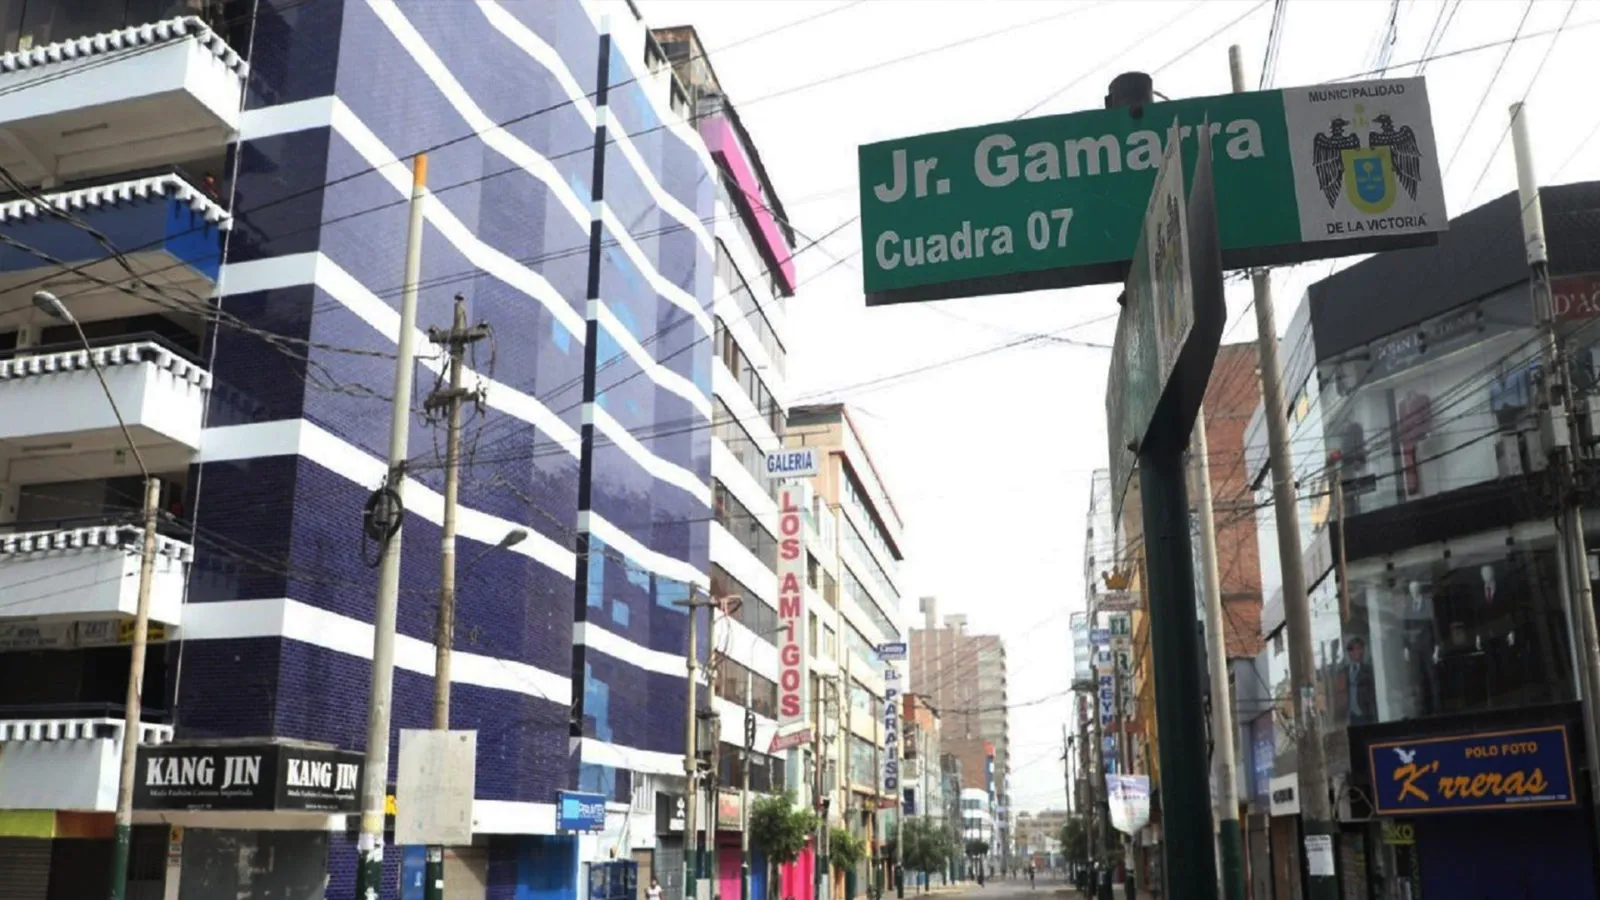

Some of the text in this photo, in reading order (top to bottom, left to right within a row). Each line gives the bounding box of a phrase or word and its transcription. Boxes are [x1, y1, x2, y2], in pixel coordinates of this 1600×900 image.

[1308, 84, 1405, 103] MUNICIPALIDAD
[873, 149, 950, 203] Jr.
[875, 208, 1074, 271] Cuadra 07
[1326, 214, 1427, 234] DE LA VICTORIA
[767, 451, 812, 472] GALERIA
[781, 491, 800, 559] LOS
[780, 572, 800, 716] AMIGOS
[885, 689, 897, 789] PARAISO
[1465, 742, 1537, 759] POLO FOTO
[146, 756, 261, 788] KANG JIN
[286, 759, 359, 792] KANG JIN
